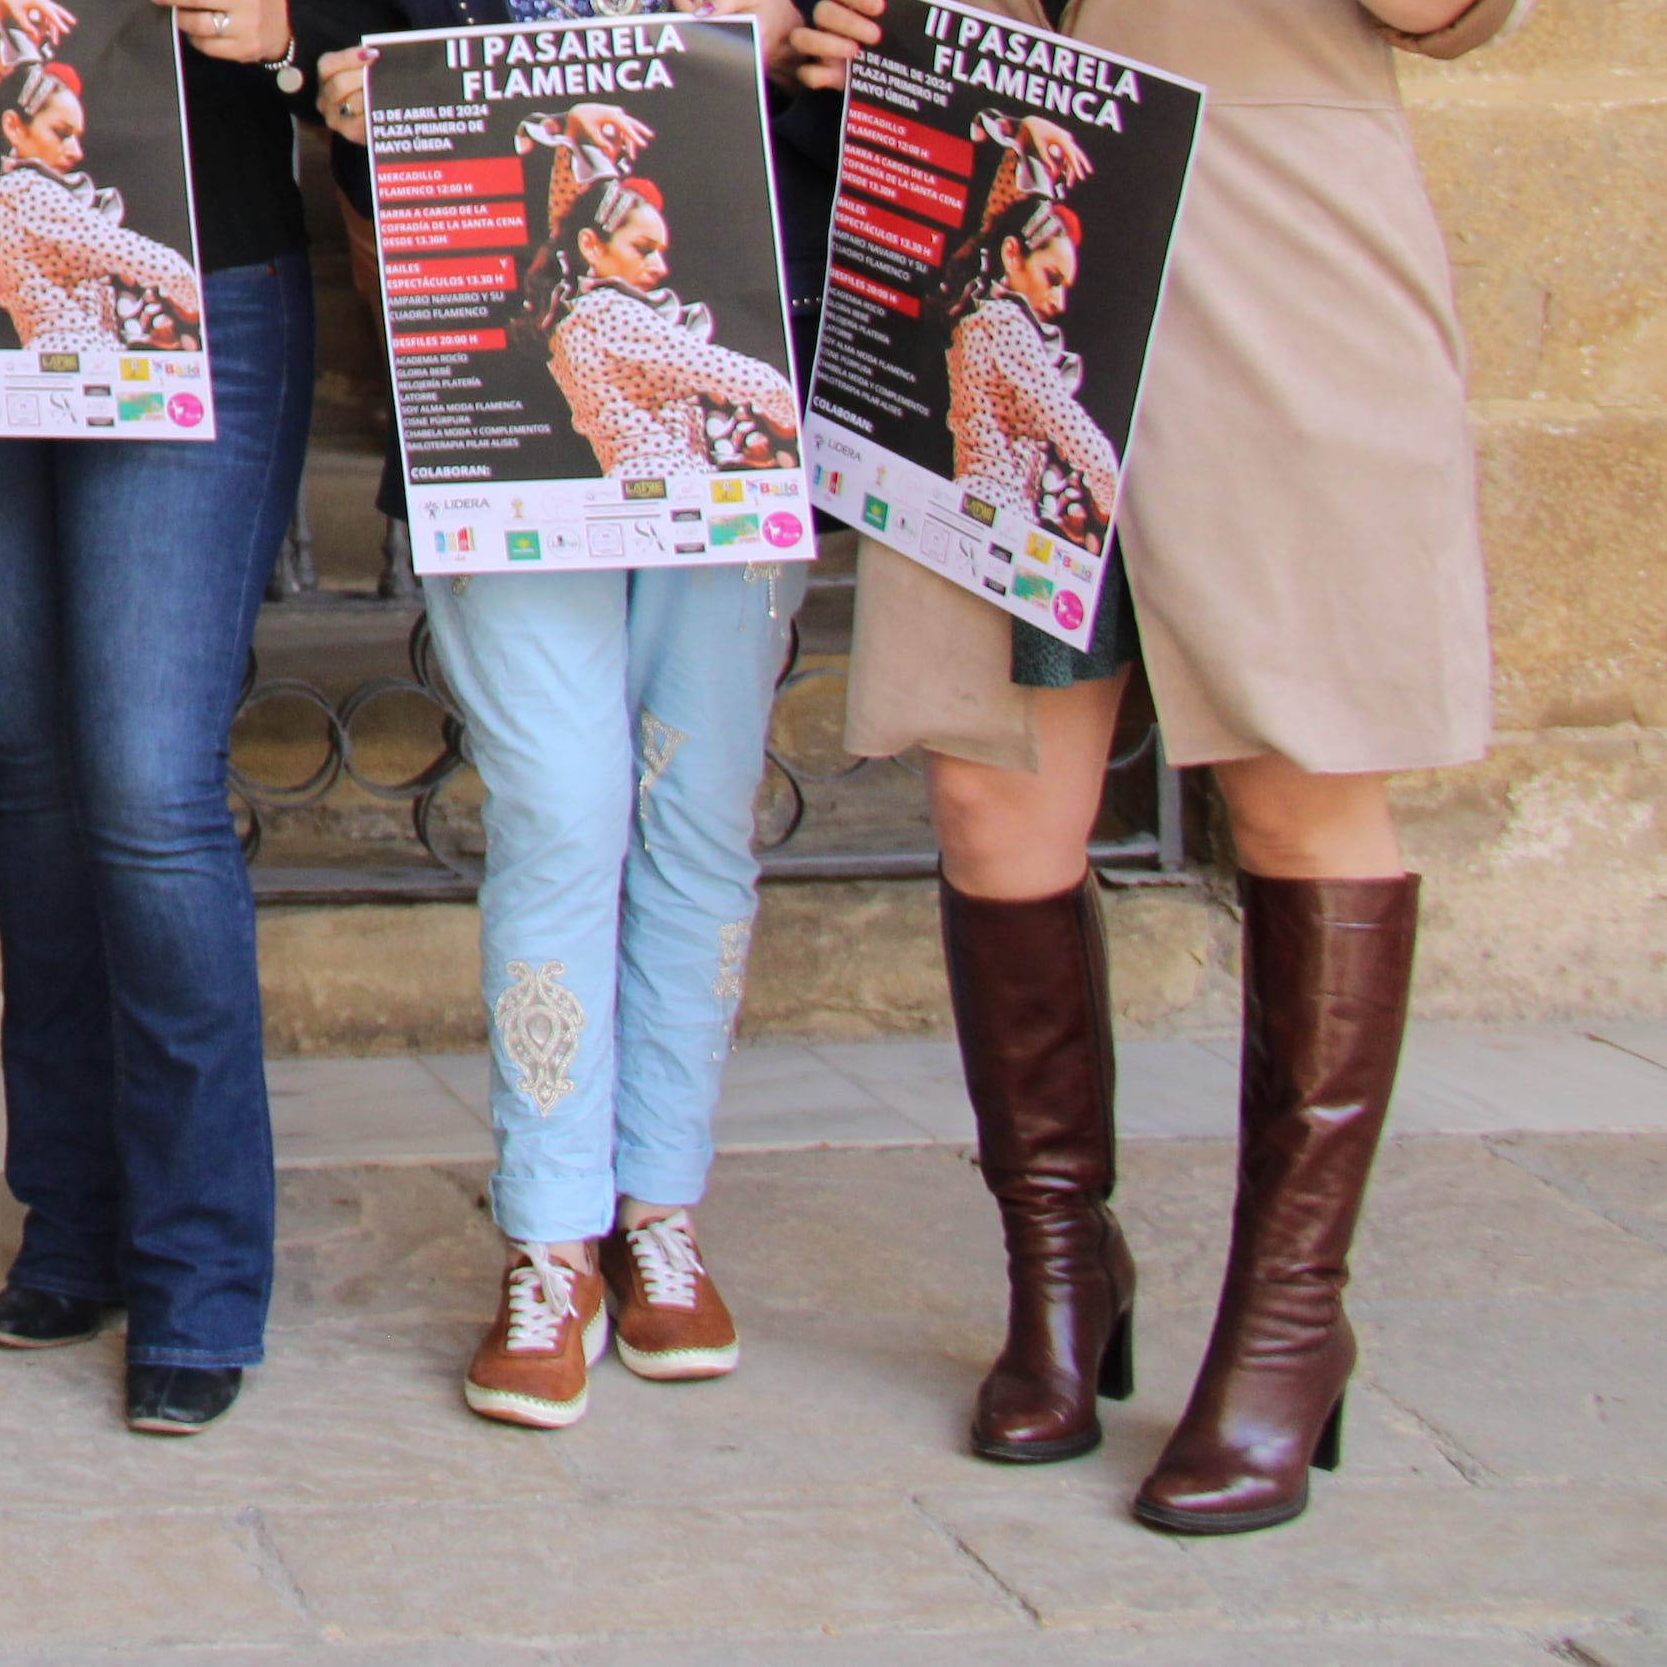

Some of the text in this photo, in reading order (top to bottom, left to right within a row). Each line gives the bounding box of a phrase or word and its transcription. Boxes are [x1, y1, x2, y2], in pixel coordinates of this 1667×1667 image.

[447, 23, 685, 68] II PASARELA
[925, 8, 1139, 102] II PASARELA
[463, 58, 674, 101] FLAMENCA
[854, 61, 886, 85] PLAZA
[887, 74, 932, 101] PRIMERO
[881, 56, 909, 77] ABRIL
[925, 73, 954, 93] 2024
[853, 76, 918, 112] MAYO ÚBEDA
[934, 44, 1120, 134] FLAMENCA
[371, 104, 489, 121] 13 DE ABRIL DE 2024
[373, 120, 485, 137] PLAZA PRIMERO DE
[374, 134, 453, 153] MAYO ÚBEDA
[377, 170, 442, 182] MERCADILLO
[378, 183, 473, 197] FLAMENCO 12:00 H
[380, 205, 487, 219] BARRA A CARGO DE LA
[380, 217, 523, 233] COFRADÍA DE LA SANTA CENA
[382, 235, 448, 246] DESDE 13.30H
[385, 258, 508, 274] BAILES Y
[386, 274, 504, 289] ESPECTÁCULOS 13.30 H
[388, 291, 504, 306] AMPARO NAVARRO Y SU
[389, 306, 488, 320] CUADRO FLAMENCO
[392, 335, 477, 347] DESFILES 20:00 H
[812, 394, 873, 434] COLABORAN:
[410, 464, 490, 479] COLABORAN:
